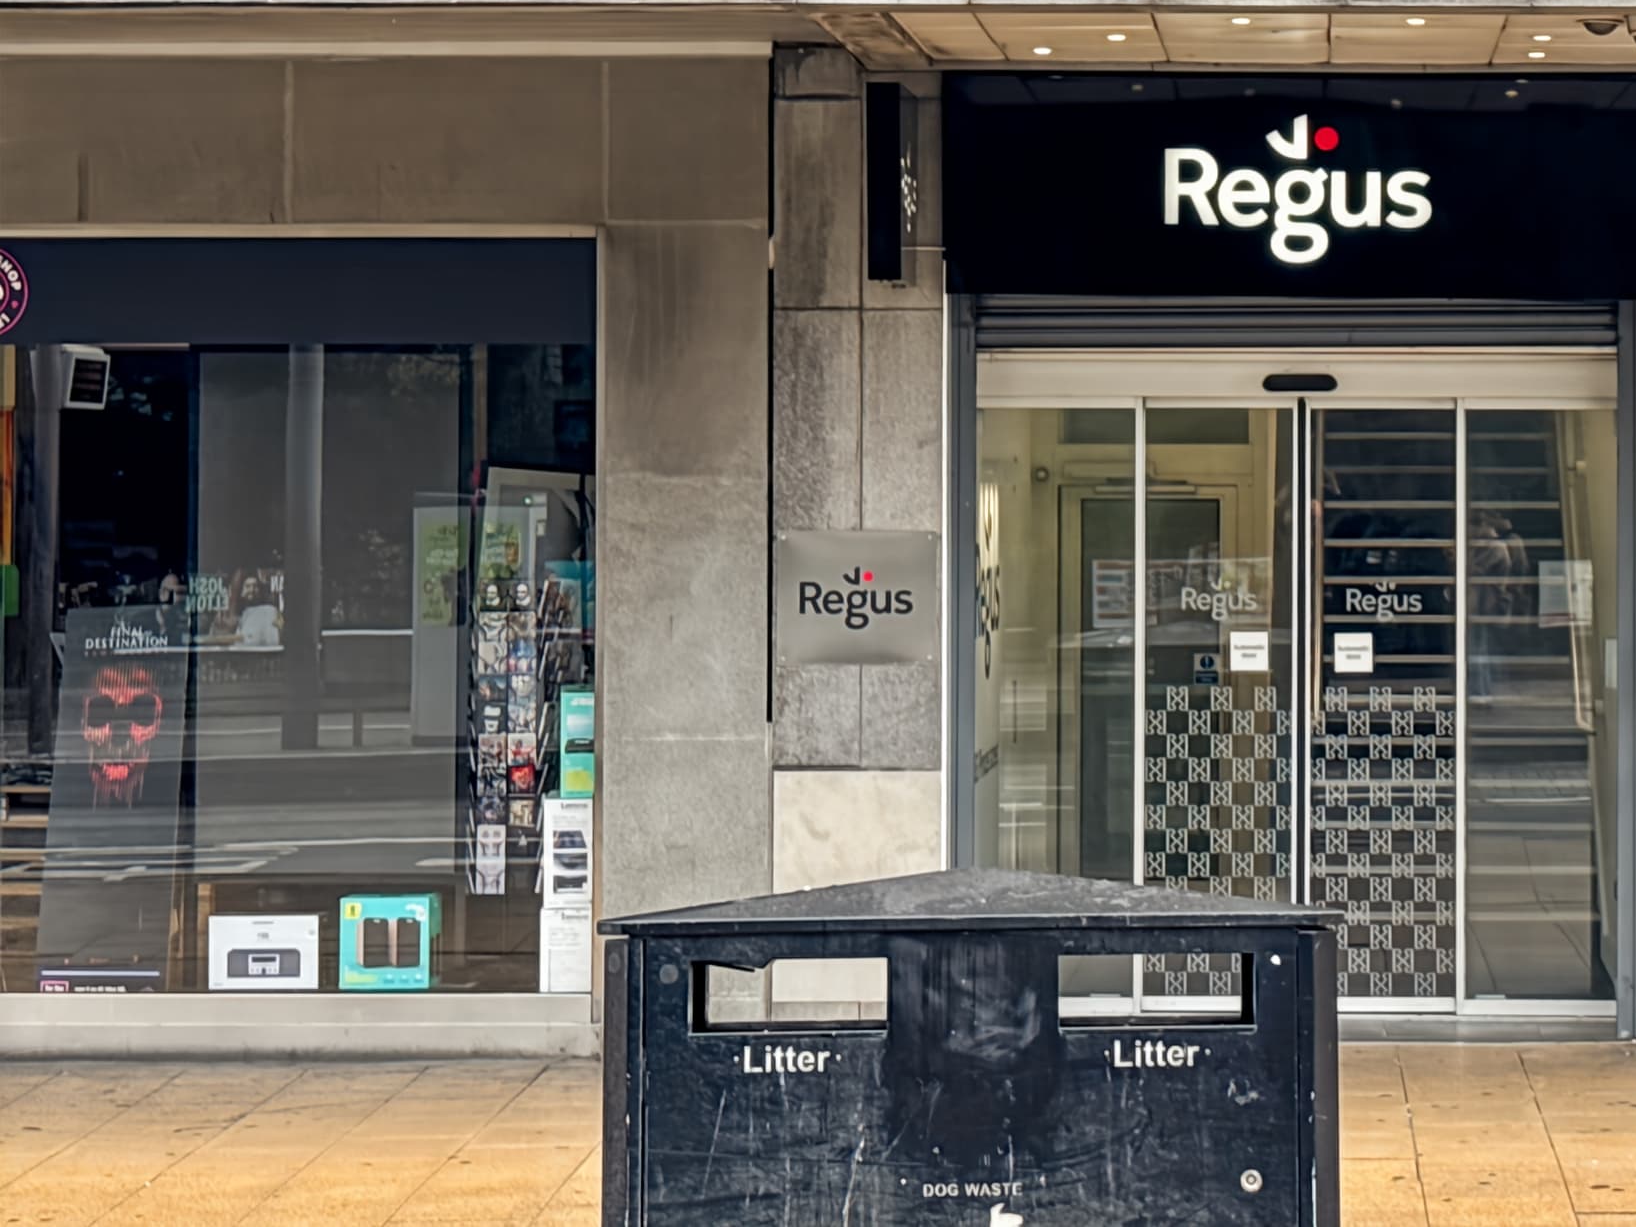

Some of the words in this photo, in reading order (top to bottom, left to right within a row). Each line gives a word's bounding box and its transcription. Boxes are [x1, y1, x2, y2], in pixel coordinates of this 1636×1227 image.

[1164, 147, 1432, 265] Regus
[0, 255, 22, 291] HOP
[799, 580, 914, 630] Regus
[1181, 586, 1258, 621] Regus
[1345, 588, 1423, 622] Regus
[85, 636, 169, 650] DESTINATION
[111, 625, 144, 638] FINAL
[743, 1045, 830, 1074] Litter
[1113, 1040, 1200, 1069] Litter
[923, 1183, 959, 1197] DOG
[964, 1182, 1023, 1197] WASTE
